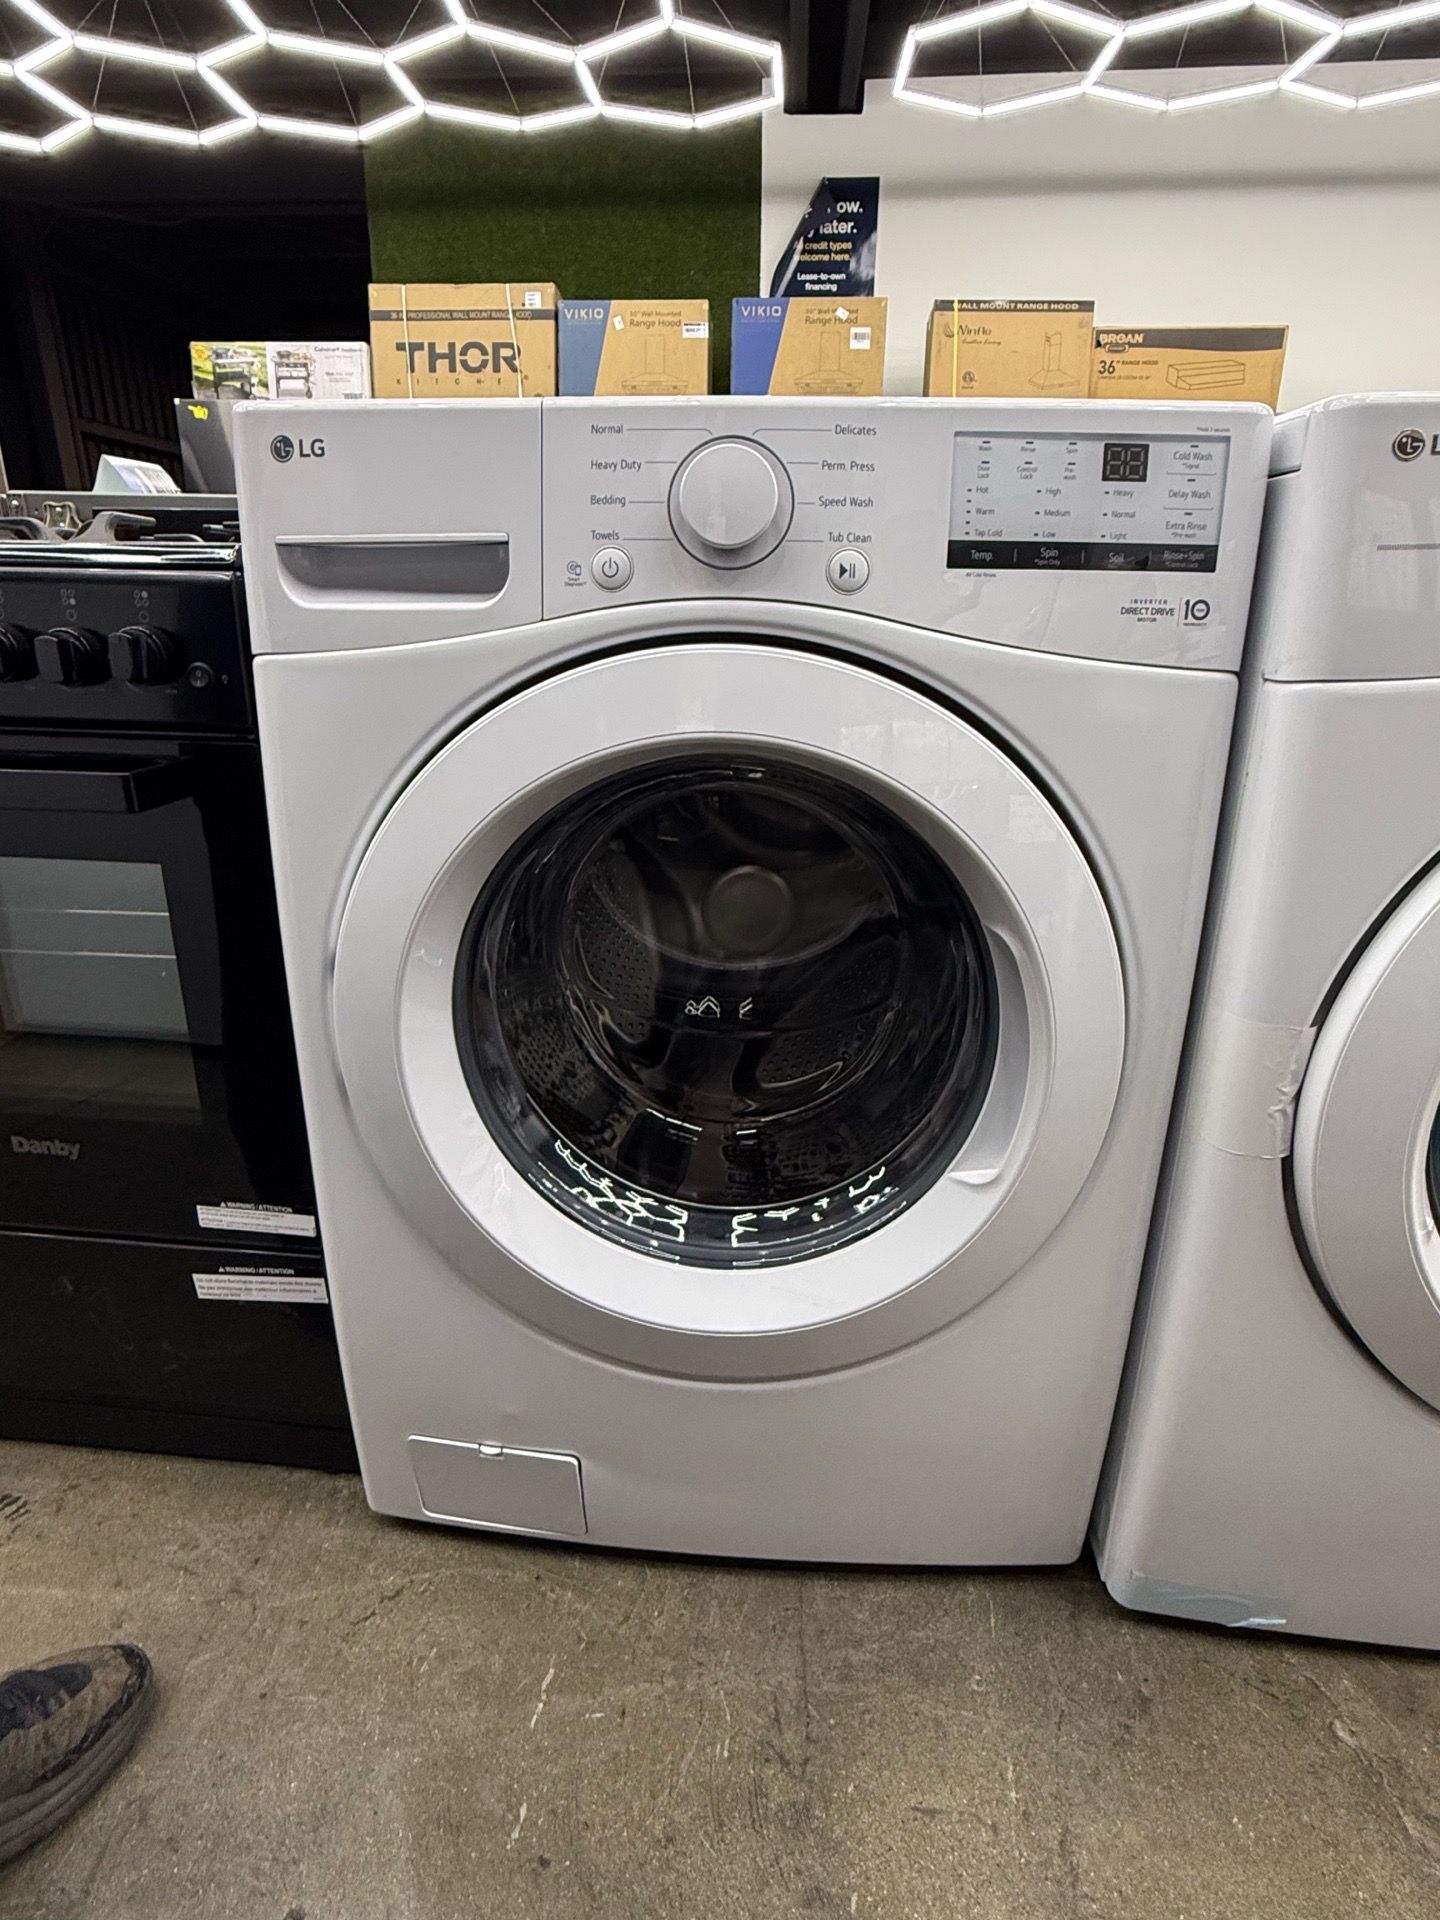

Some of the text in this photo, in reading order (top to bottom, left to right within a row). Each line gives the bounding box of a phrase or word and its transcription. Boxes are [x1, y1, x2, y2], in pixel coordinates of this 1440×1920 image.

[828, 201, 863, 213] ow.
[805, 241, 828, 250] credit
[830, 241, 852, 251] types
[799, 252, 830, 261] elcome
[797, 272, 846, 280] Lease-to-own
[805, 283, 837, 292] financing
[741, 305, 782, 316] VIKIO
[980, 302, 1015, 310] MOUNT
[1016, 302, 1049, 310] RANGE
[1051, 302, 1079, 310] HOOD
[408, 311, 451, 319] PROFESSIONAL
[453, 311, 468, 319] WALL
[469, 311, 490, 319] MOUNT
[564, 308, 604, 319] VIKIO
[629, 319, 656, 329] Range
[658, 319, 682, 328] Hood
[805, 316, 832, 327] Range
[1099, 333, 1144, 344] BROAN
[395, 342, 521, 373] THOR
[591, 424, 624, 434] Normal
[834, 424, 877, 436] Delicates
[299, 438, 326, 458] LG
[1430, 433, 1440, 456] L
[1066, 447, 1078, 455] Spin
[1173, 451, 1213, 461] Cold Wash
[590, 459, 642, 472] Heavy Duty
[821, 460, 876, 472] Perm. Press
[976, 486, 988, 494] Hot
[1045, 487, 1062, 497] High
[1113, 489, 1135, 498] Heavy
[1168, 489, 1211, 500] Delay Wash
[590, 495, 626, 508] Bedding
[818, 496, 873, 509] Speed Wash
[1043, 509, 1071, 517] Medium
[1111, 511, 1136, 519] Normal
[1165, 521, 1208, 531] Extra Rinse
[591, 530, 620, 540] Towels
[828, 532, 872, 543] Tub Clean
[974, 529, 1003, 538] Tap Cold
[1042, 530, 1056, 538] Low
[1110, 532, 1127, 541] Light
[1040, 548, 1059, 559] Spin
[1108, 552, 1124, 562] Soil
[1120, 606, 1176, 617] DIRECT DRIVE
[1184, 599, 1211, 621] 10
[11, 1135, 81, 1160] Danby
[226, 1201, 256, 1211] WARNING
[258, 1203, 293, 1213] ATTENTION
[225, 1266, 256, 1274] WARNING
[258, 1267, 295, 1275] ATTENTION
